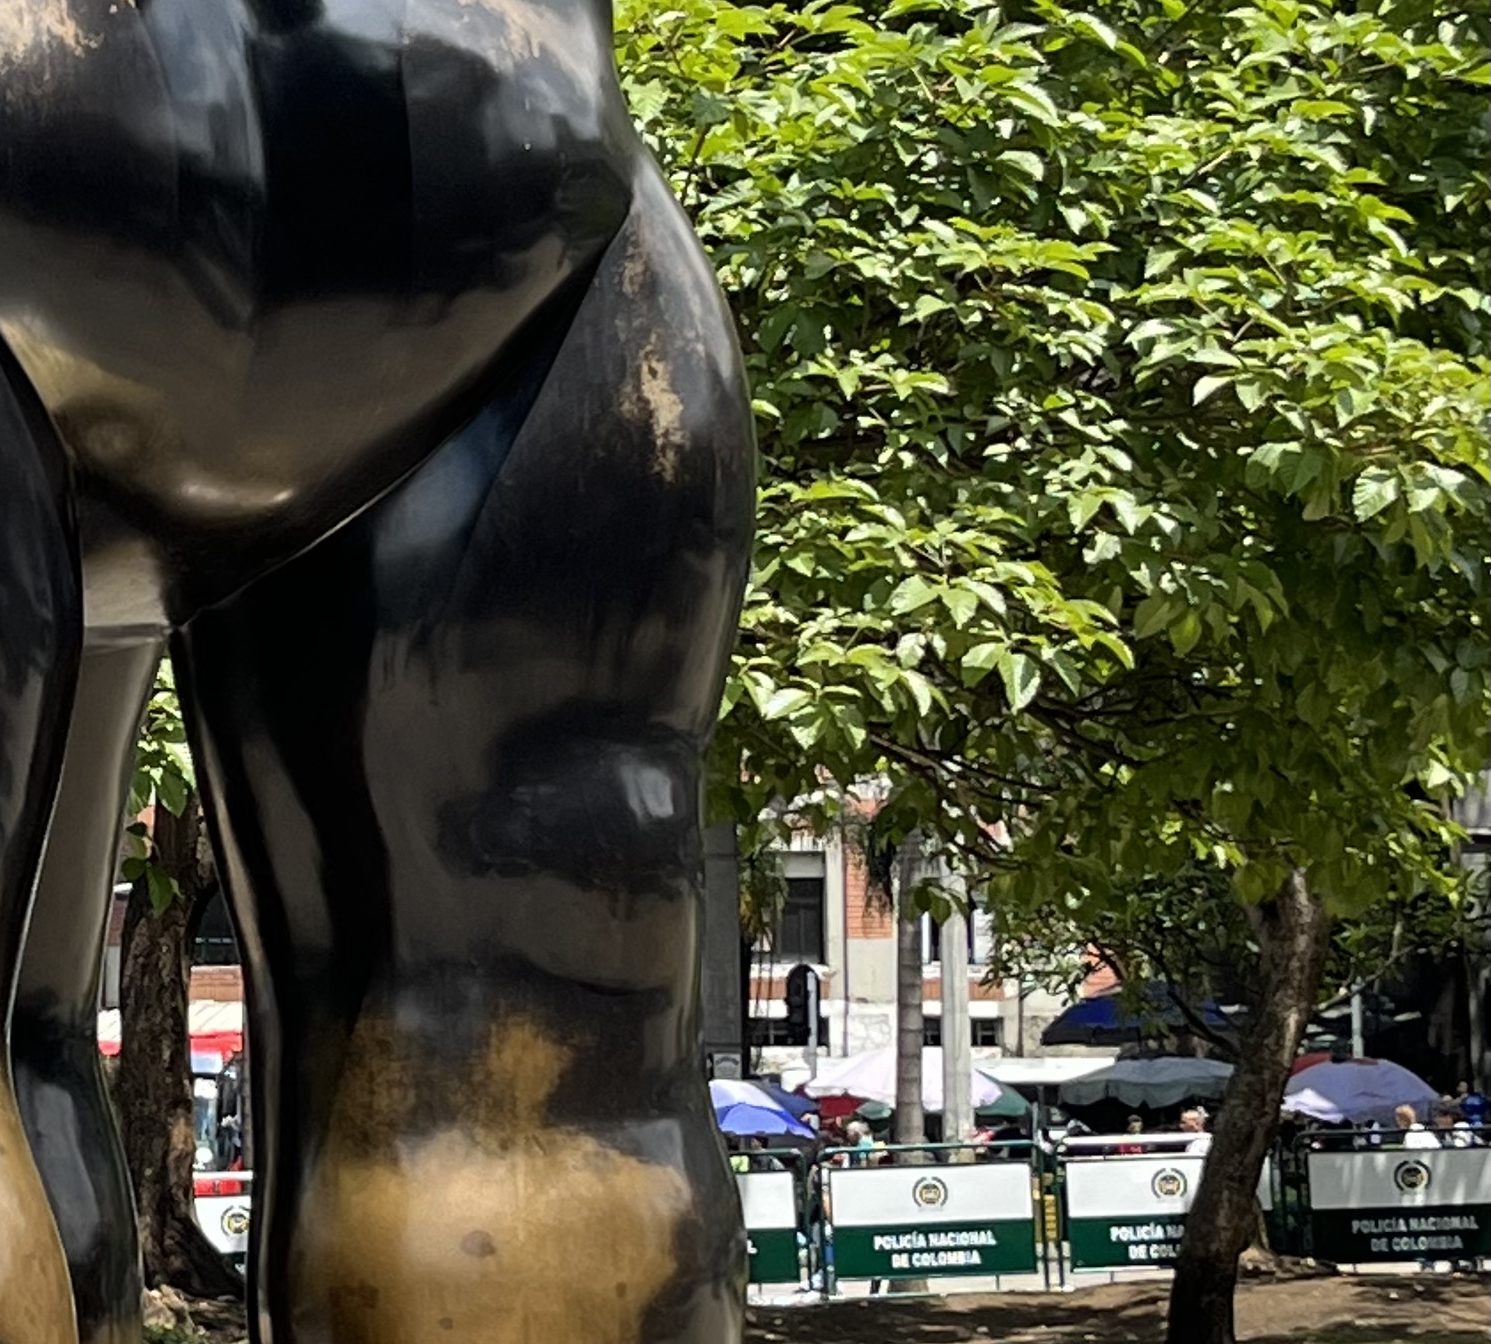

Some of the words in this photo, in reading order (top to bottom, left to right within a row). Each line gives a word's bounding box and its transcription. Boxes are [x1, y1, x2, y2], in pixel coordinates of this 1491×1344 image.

[1110, 1222, 1164, 1242] POLICÍA
[1351, 1217, 1408, 1234] POLICÍA
[1408, 1215, 1480, 1231] NACIONAL
[873, 1231, 927, 1250] POLICÍA
[928, 1230, 996, 1247] NACIONAL
[1371, 1237, 1389, 1252] DE
[1392, 1235, 1464, 1252] COLOMBIA
[891, 1253, 910, 1268] DE
[912, 1250, 981, 1267] COLOMBIA
[1128, 1244, 1148, 1260] DE
